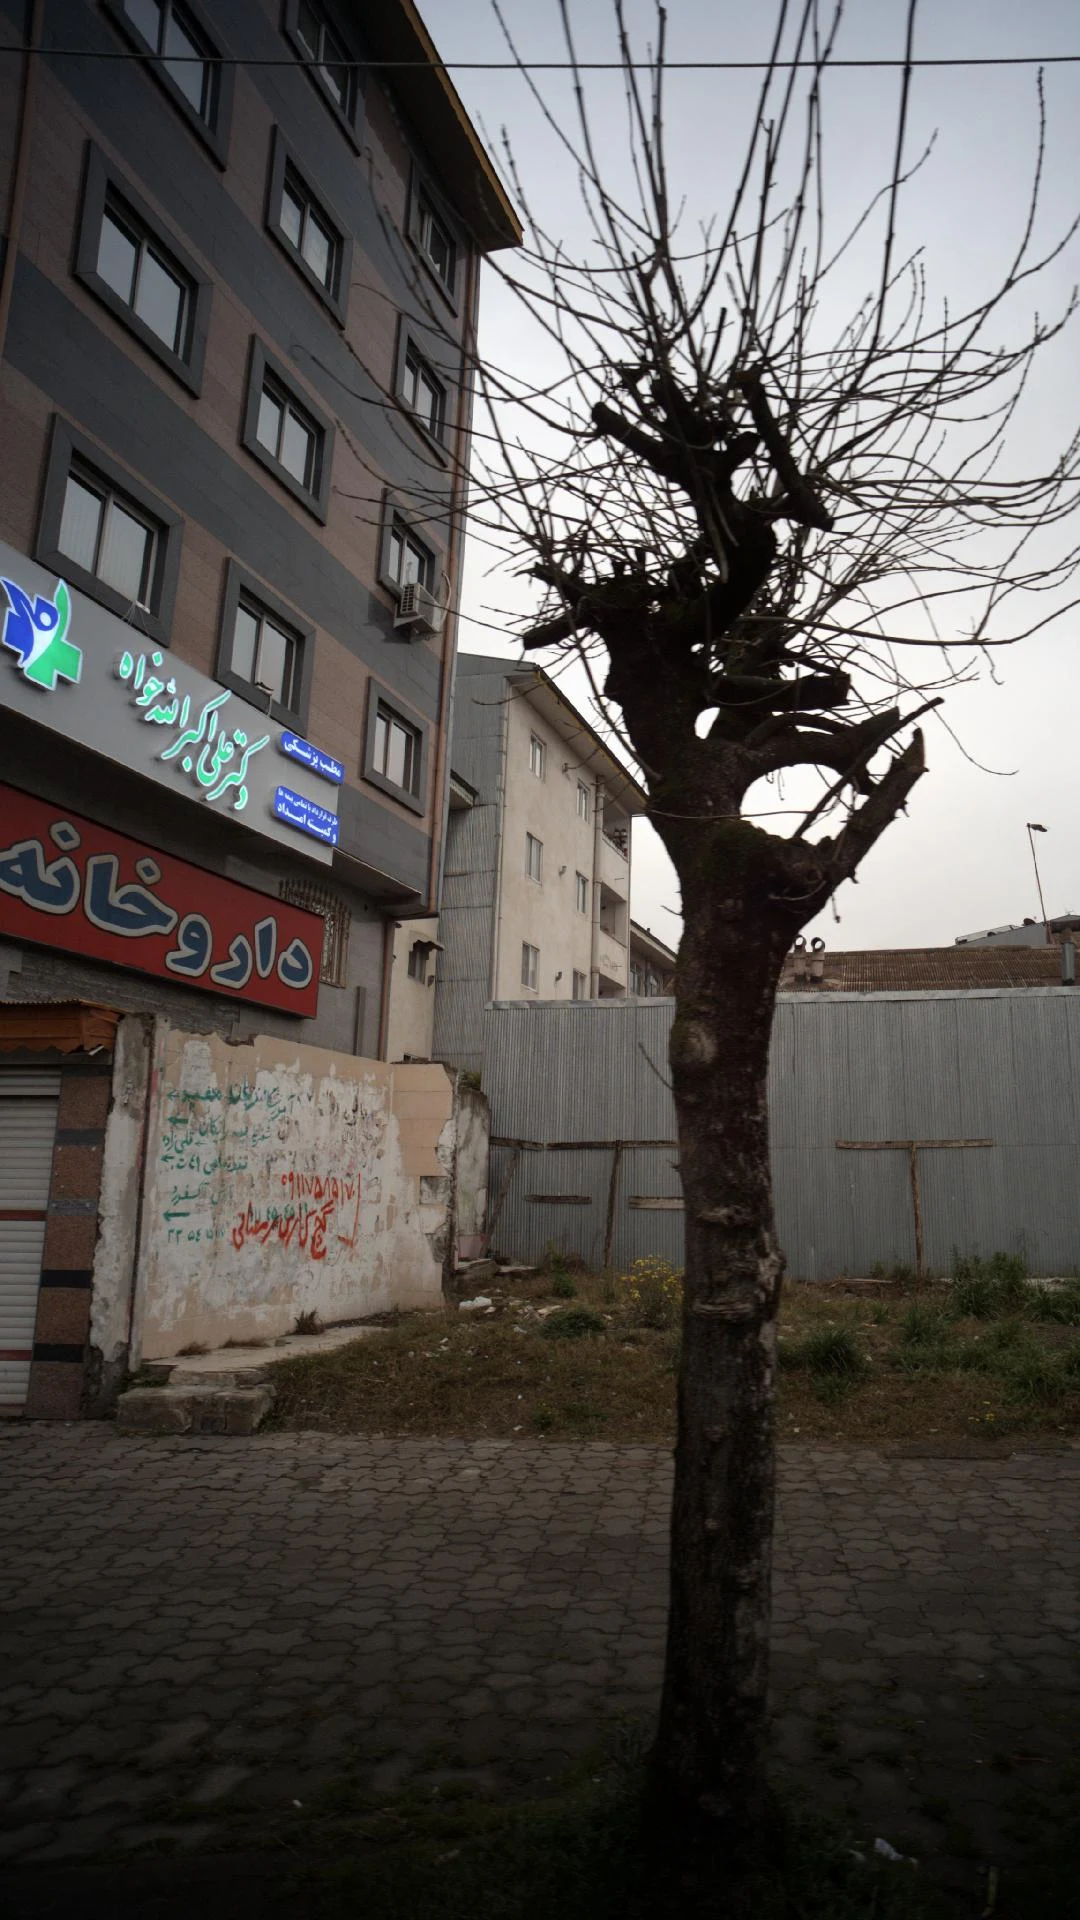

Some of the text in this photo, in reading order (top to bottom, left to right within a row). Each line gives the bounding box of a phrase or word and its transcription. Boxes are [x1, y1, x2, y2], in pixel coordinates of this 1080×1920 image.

[161, 689, 232, 773] اکبر
[196, 730, 235, 787] علی
[284, 738, 342, 778] مطب پزشکی
[206, 728, 271, 811] دکتر
[277, 802, 338, 844] و کمیته امداد
[0, 821, 313, 990] داروخانه
